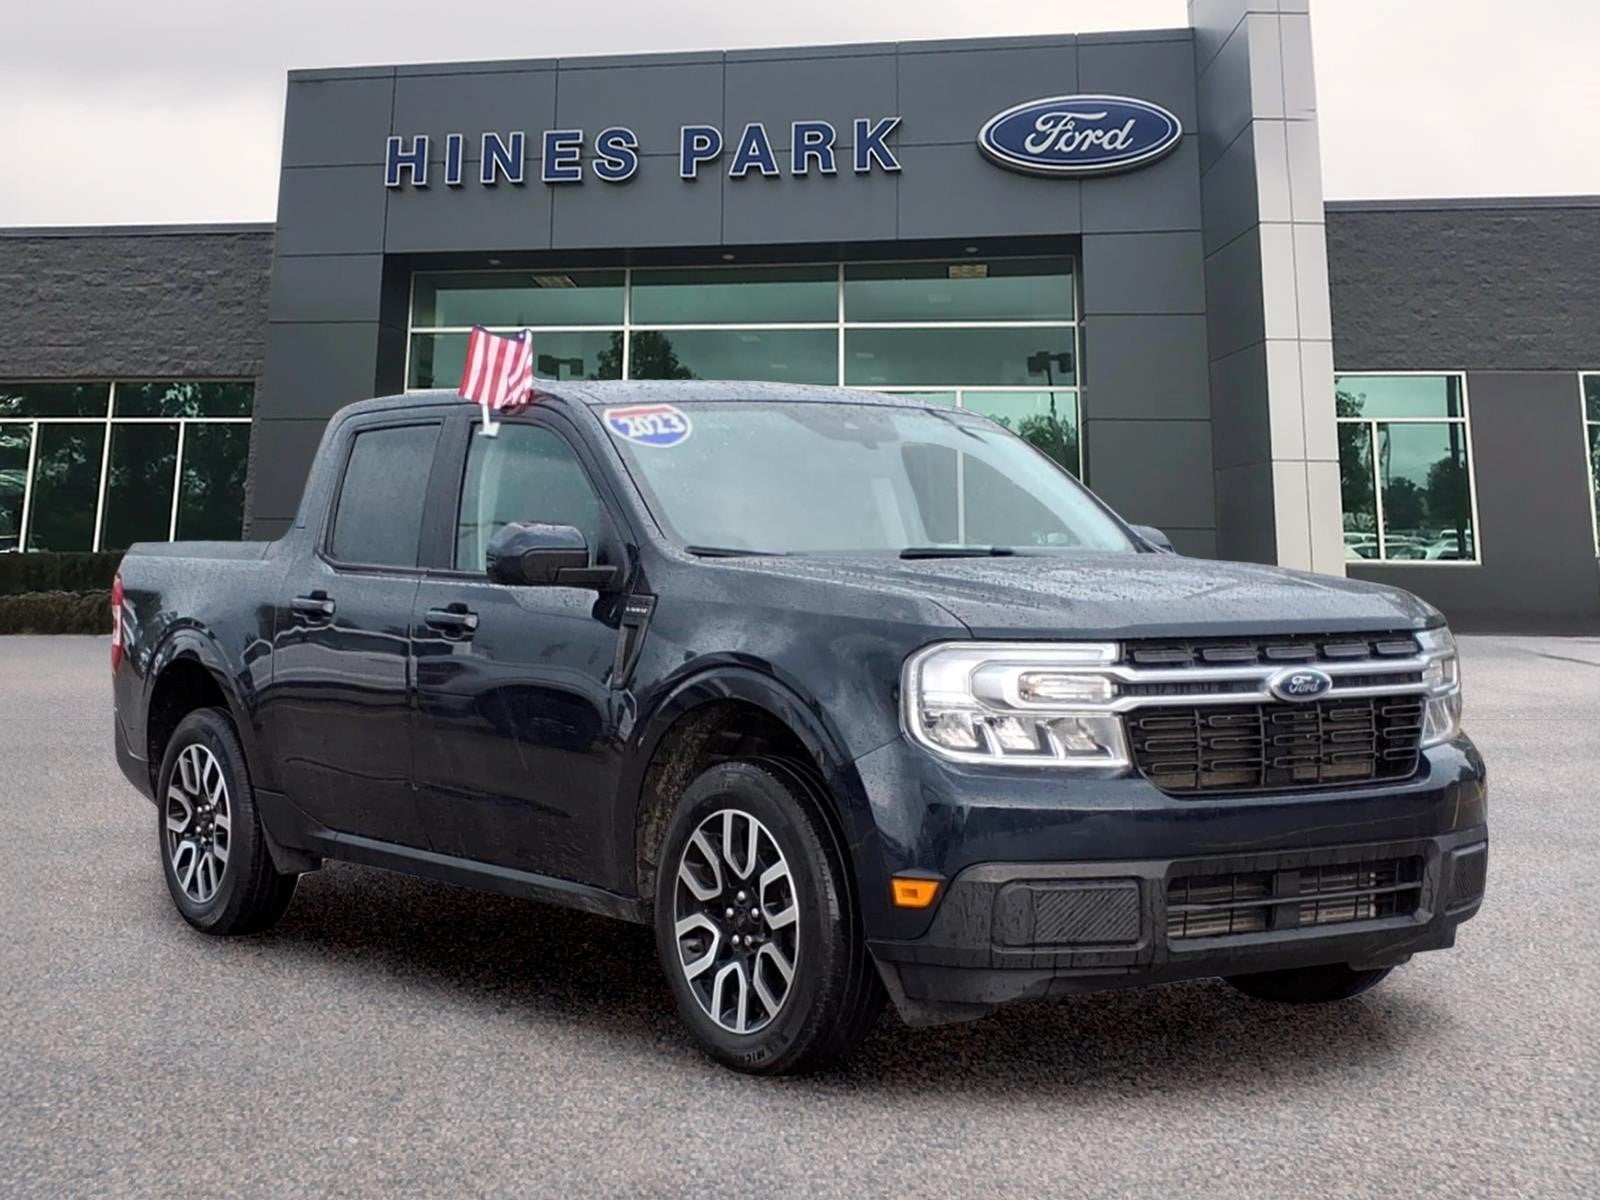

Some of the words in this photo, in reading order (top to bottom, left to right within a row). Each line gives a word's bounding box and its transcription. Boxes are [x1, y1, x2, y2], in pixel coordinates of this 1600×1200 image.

[1024, 111, 1136, 154] Ford
[385, 127, 639, 187] HINES
[679, 117, 902, 179] PARK
[618, 413, 686, 437] 2023
[1289, 675, 1320, 694] Ford
